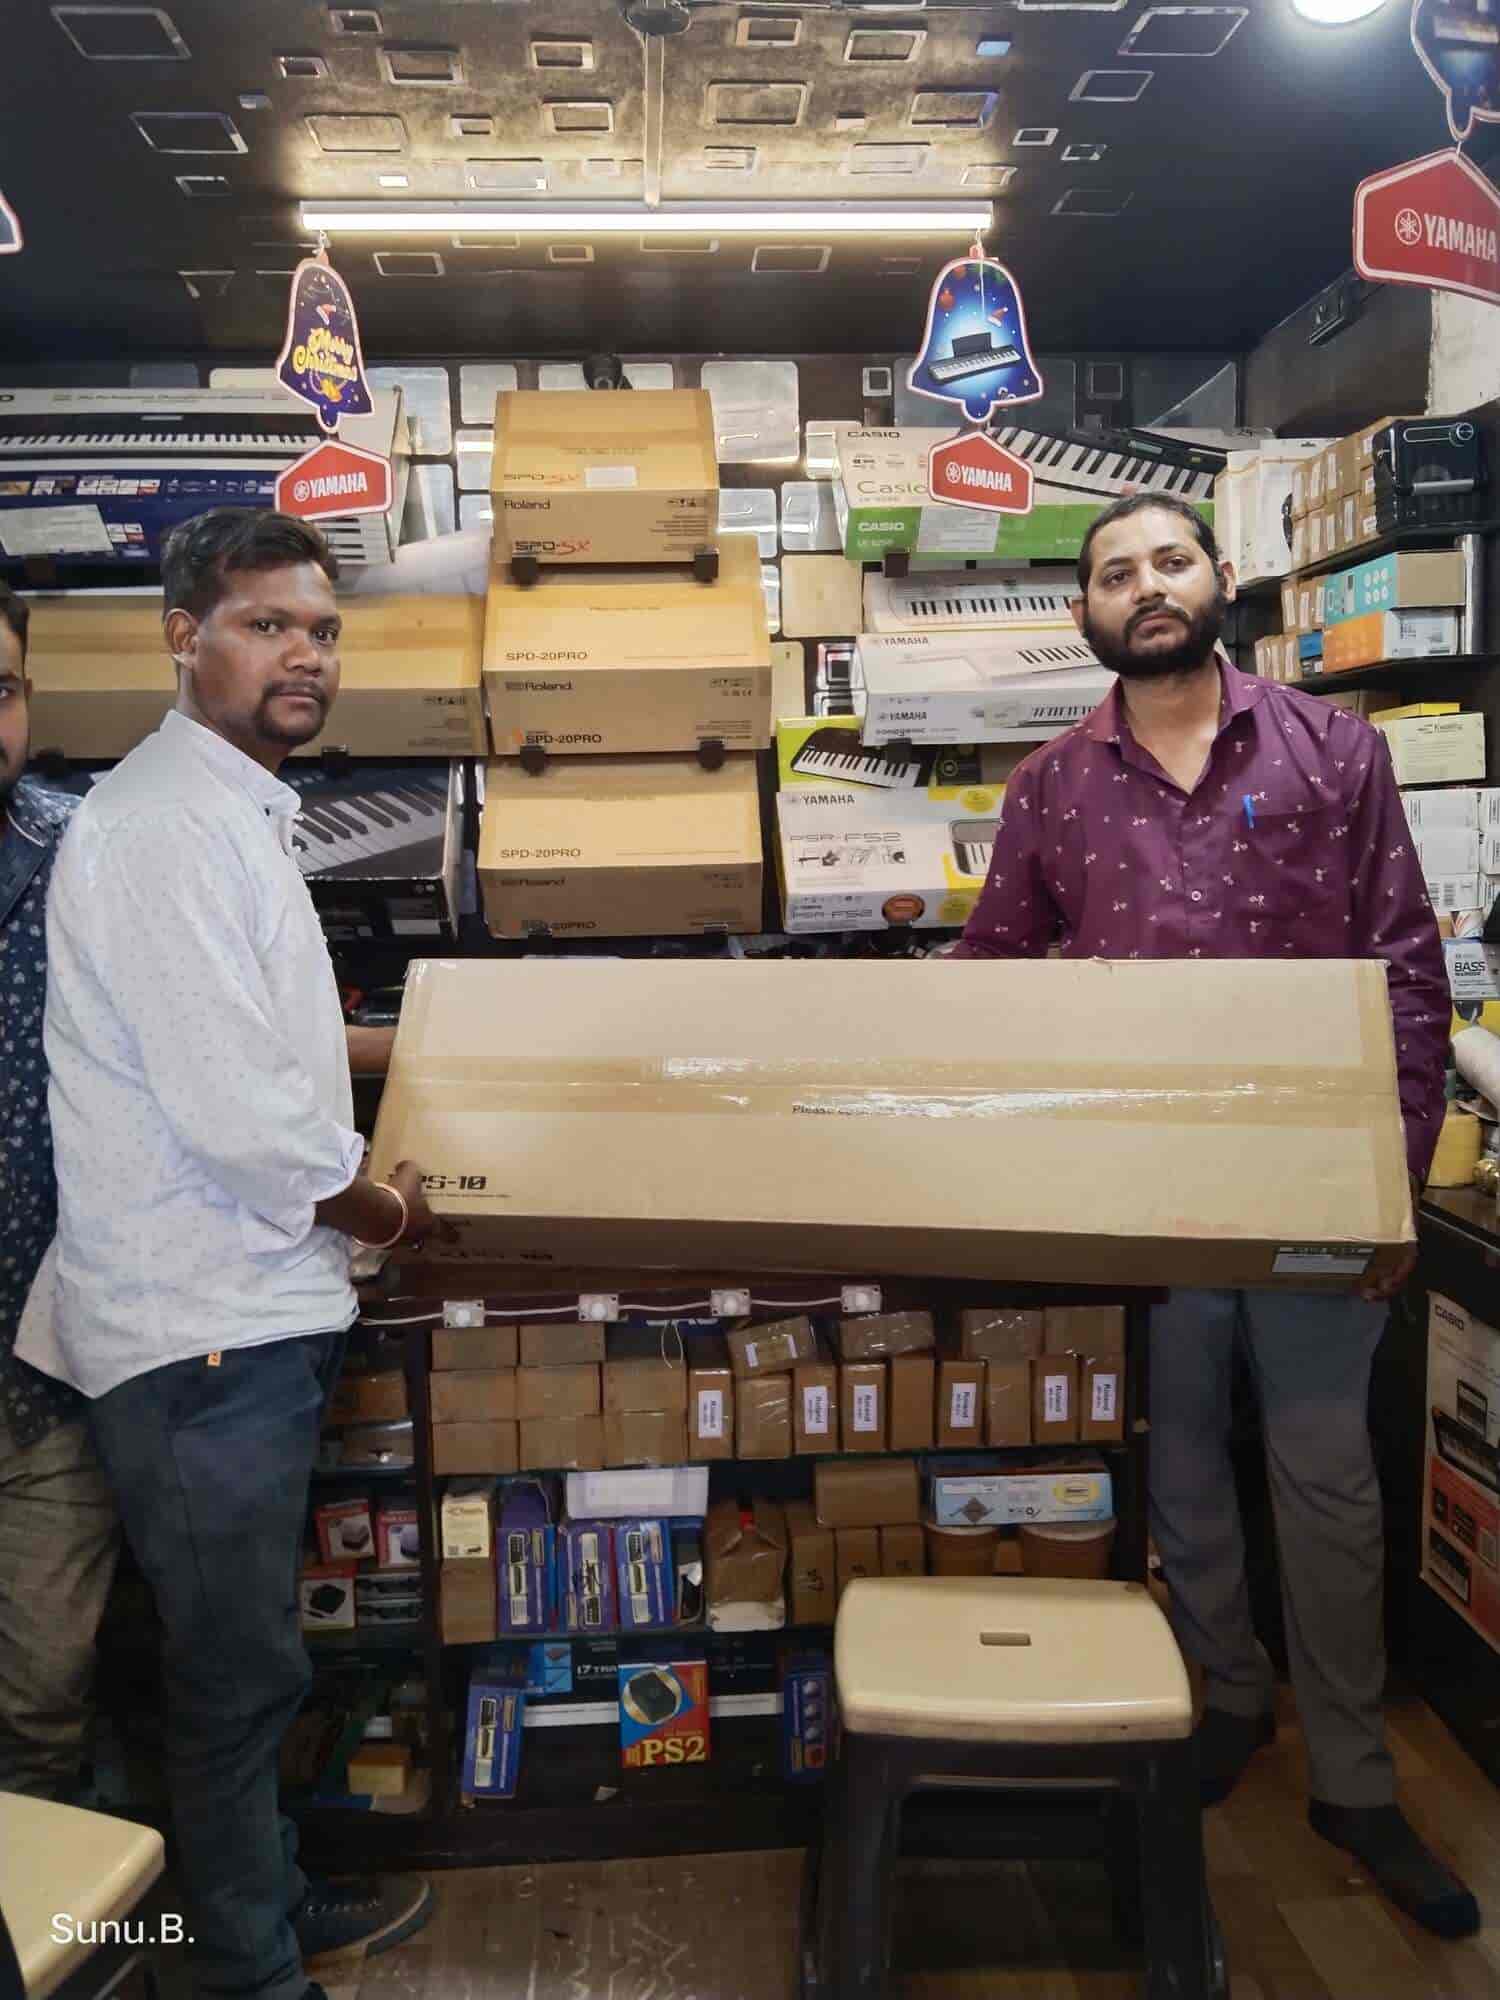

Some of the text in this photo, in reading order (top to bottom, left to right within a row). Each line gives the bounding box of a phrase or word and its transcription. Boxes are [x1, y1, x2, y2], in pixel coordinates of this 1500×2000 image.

[1424, 213, 1498, 262] YAMAHA
[847, 431, 901, 439] CASIO
[960, 465, 1014, 492] YAMAHA
[310, 472, 368, 498] YAMAHA
[504, 499, 551, 510] Roland
[857, 521, 905, 532] CASIO
[514, 540, 592, 556] SPD-SX
[884, 635, 929, 646] YAMAHA
[505, 651, 588, 662] SPD-20PRO
[522, 680, 574, 691] Roland
[889, 711, 928, 721] YAMAHA
[525, 733, 603, 745] SPD-20PRO
[803, 793, 856, 806] YAMAHA
[500, 848, 581, 859] SPD-20PRO
[1454, 961, 1486, 972] BASS
[1434, 1303, 1465, 1331] CASIO
[641, 1735, 706, 1767] PS2
